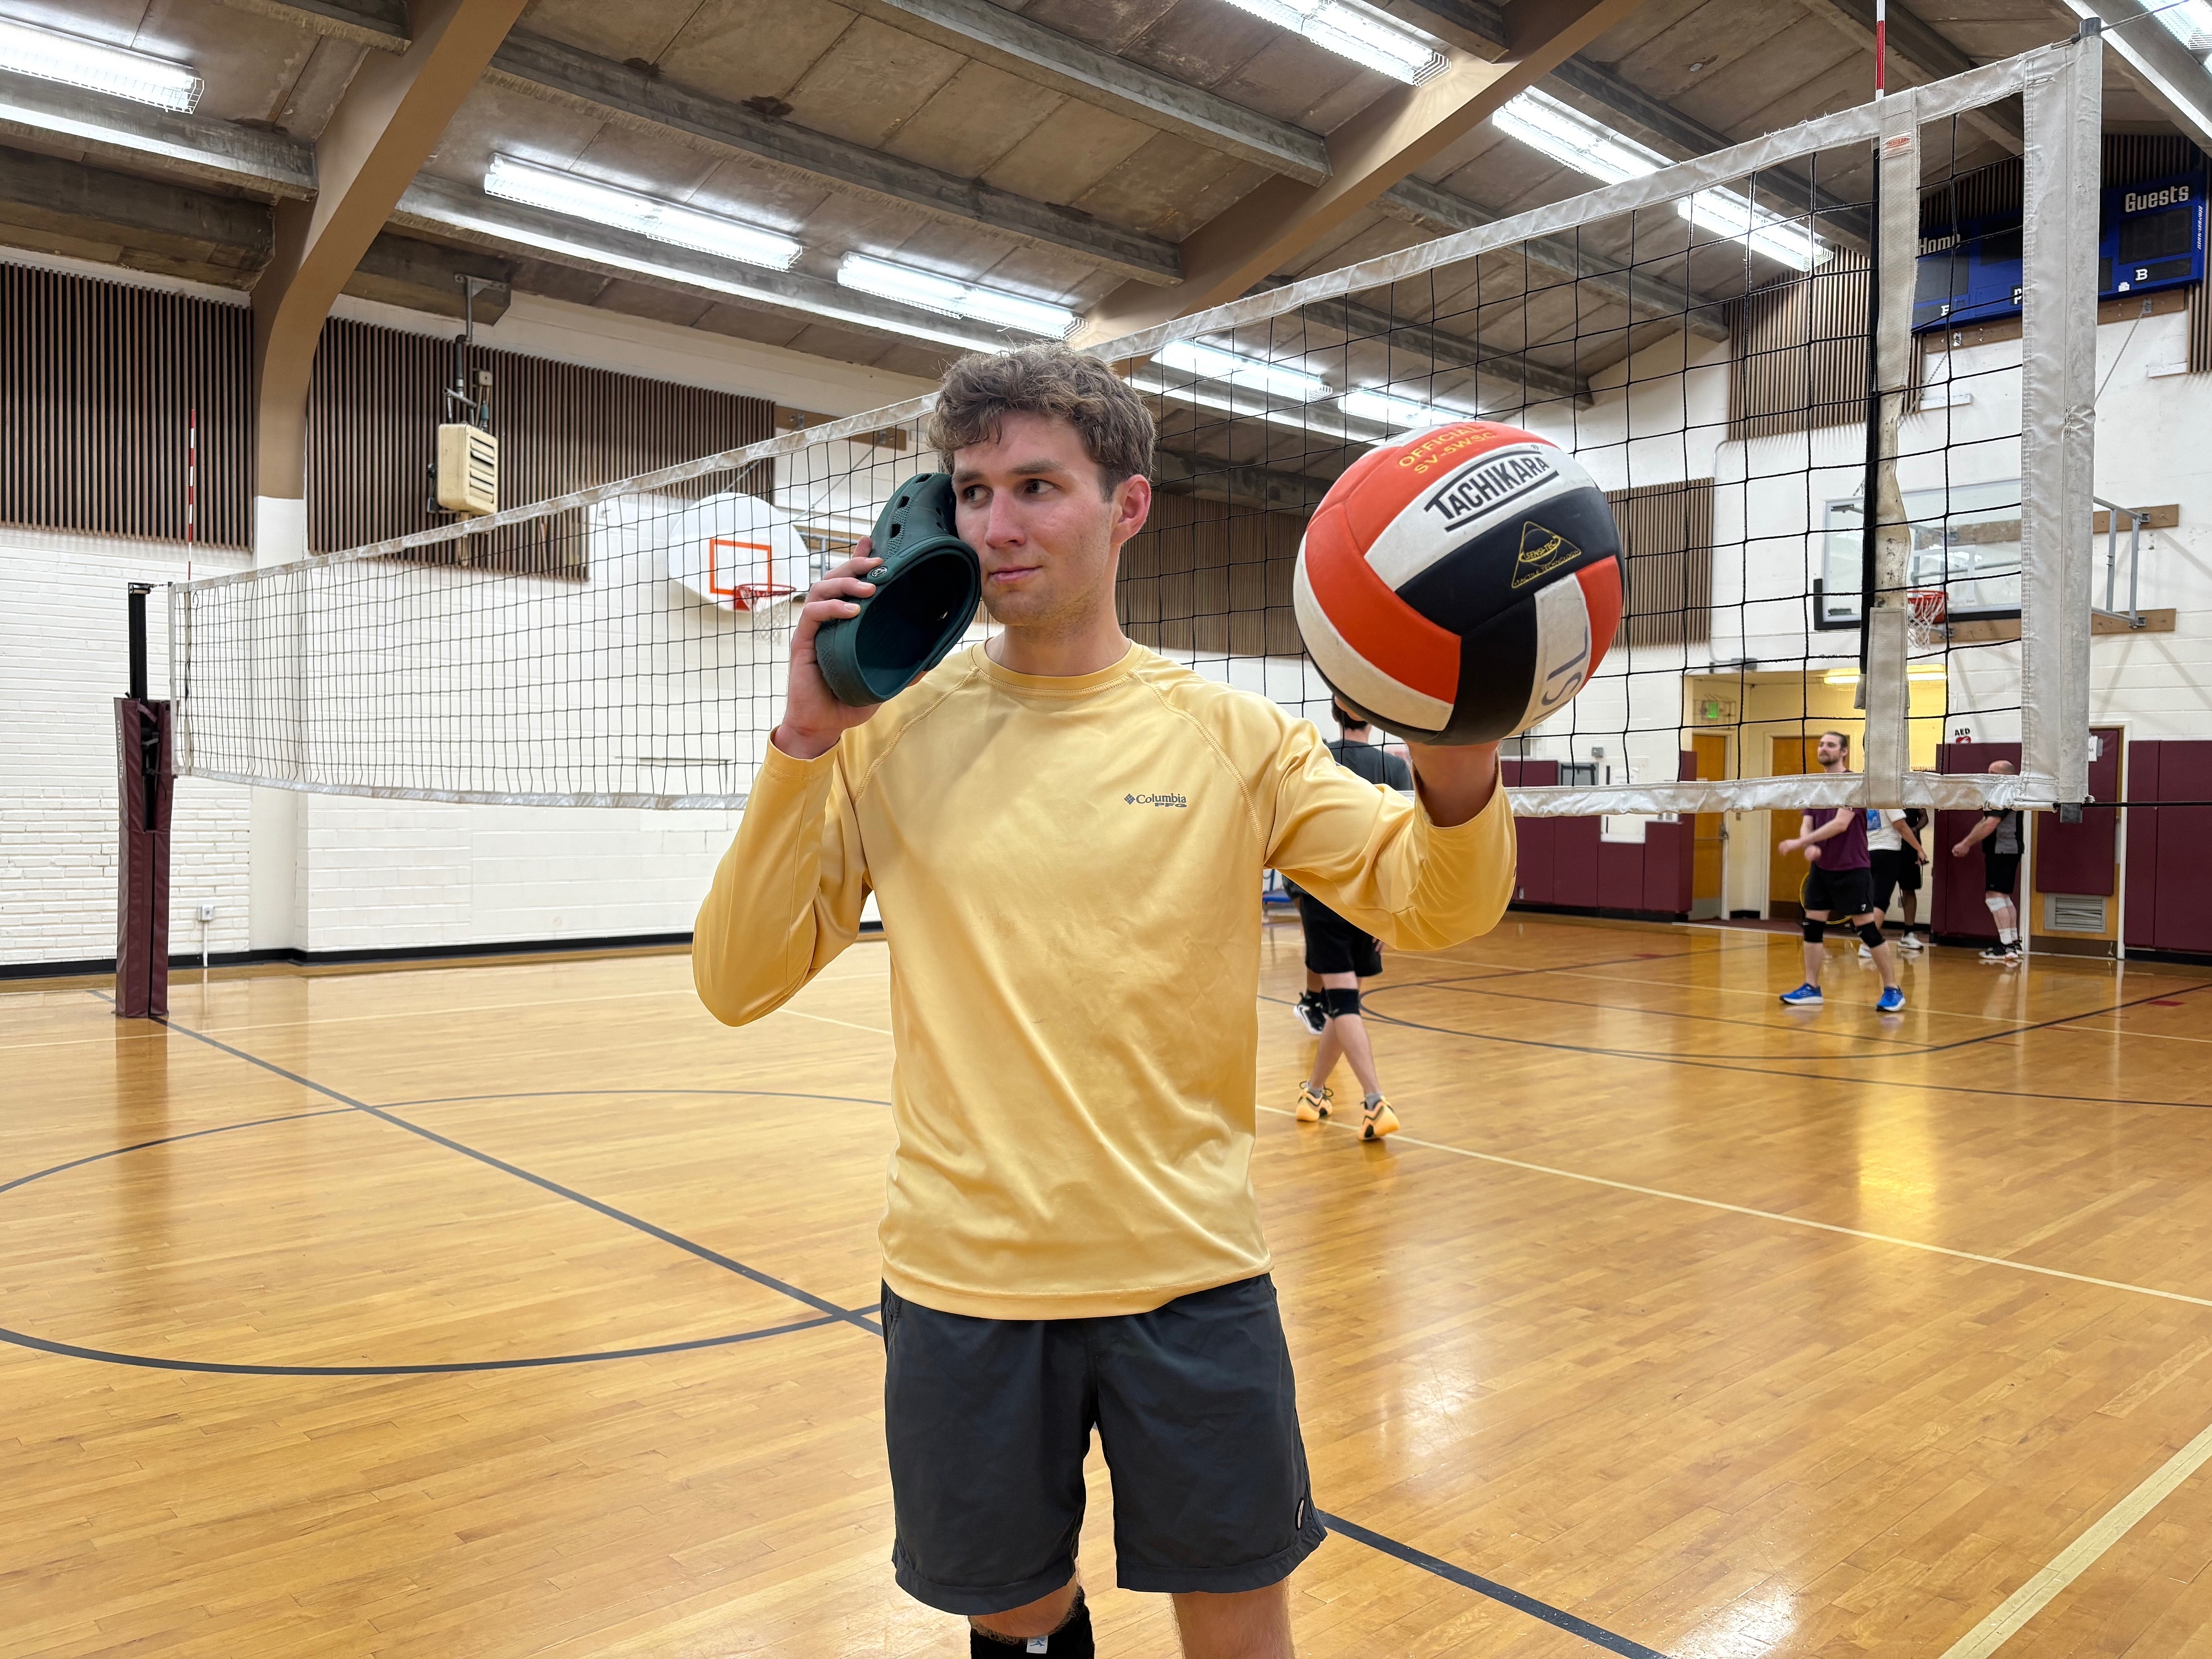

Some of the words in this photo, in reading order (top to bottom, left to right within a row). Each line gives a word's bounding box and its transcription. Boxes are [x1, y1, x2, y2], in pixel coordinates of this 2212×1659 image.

[2125, 186, 2189, 212] Guests
[2135, 268, 2148, 281] B
[1399, 425, 1485, 466] OFFICIAL
[1424, 451, 1550, 521] TACHIKARA
[1954, 728, 1971, 736] AED
[1136, 793, 1187, 804] Columbia
